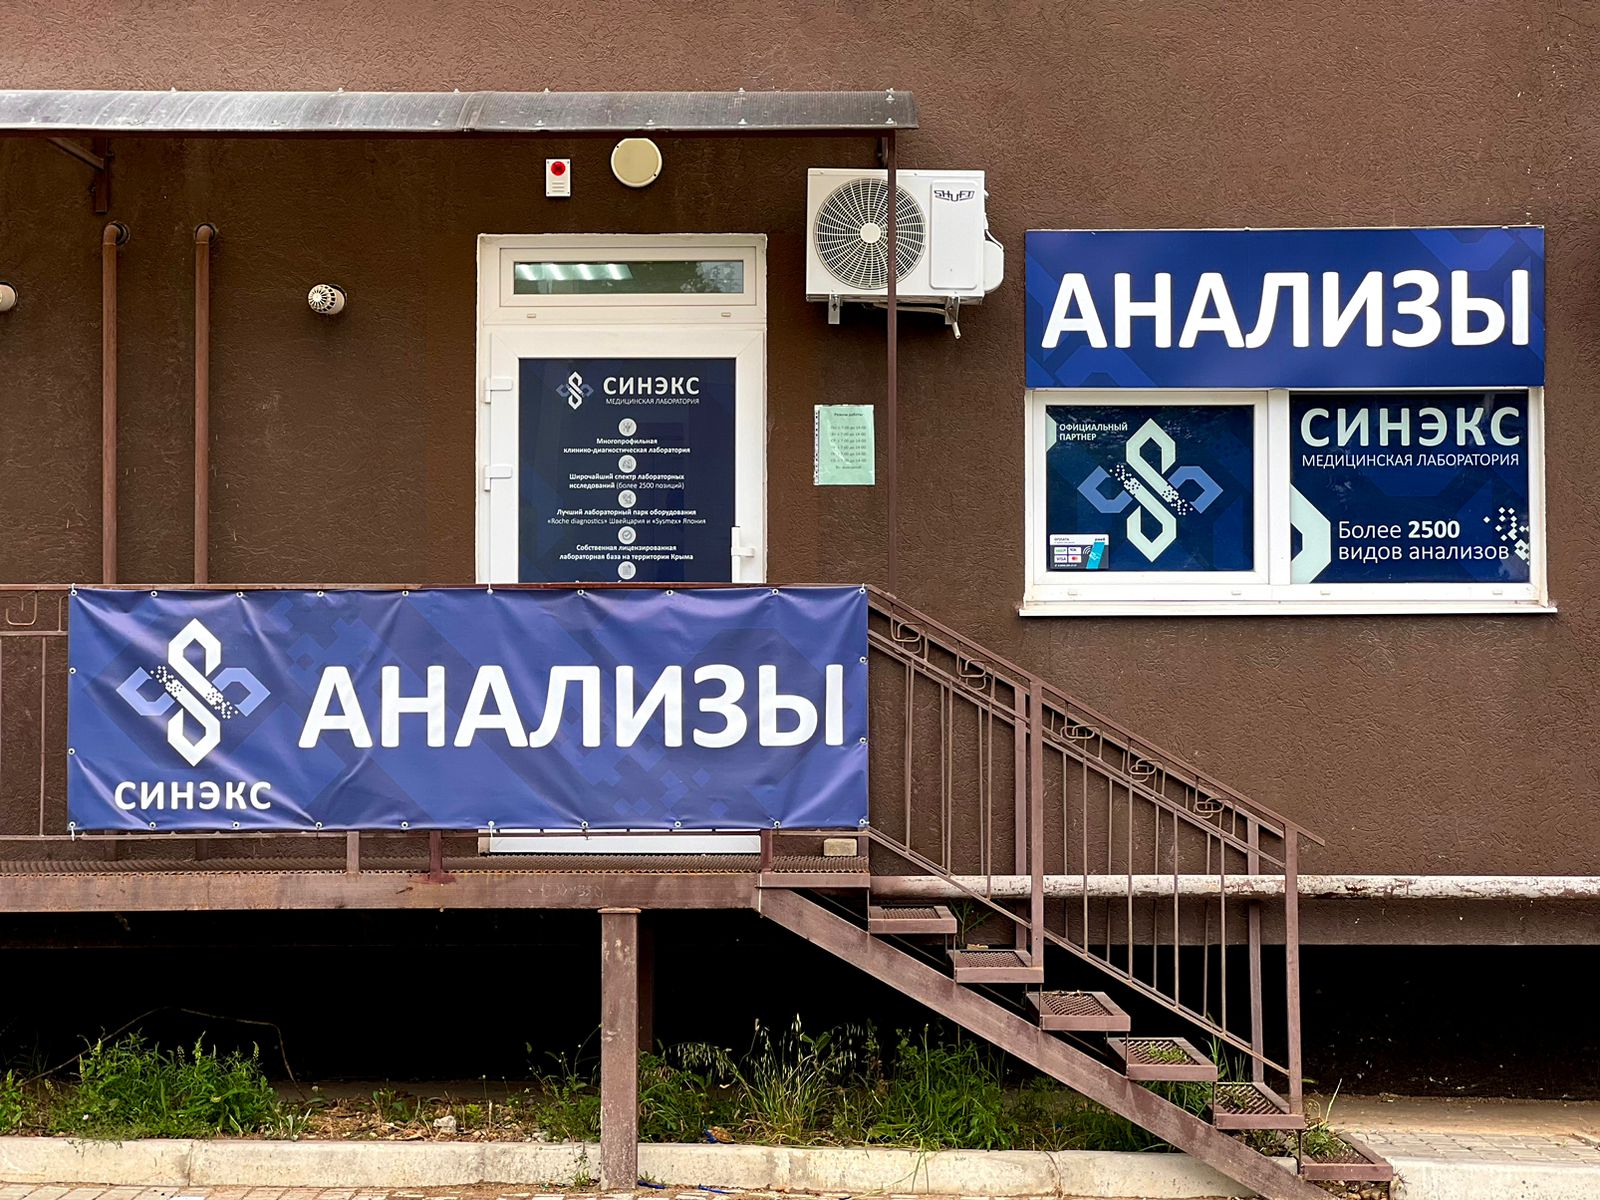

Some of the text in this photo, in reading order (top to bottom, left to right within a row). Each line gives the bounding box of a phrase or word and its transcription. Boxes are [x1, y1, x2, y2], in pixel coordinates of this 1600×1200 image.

[934, 190, 975, 202] SHUFT
[1041, 269, 1529, 349] АНАЛИЗЫ
[603, 376, 700, 395] СИНЭКС
[606, 398, 654, 406] МЕДИЦИНСКАЯ
[1059, 422, 1128, 433] ОФИЦИАЛЬНЫЙ
[1300, 407, 1520, 447] СИНЭКС
[596, 438, 658, 446] Многопрофильная
[1059, 433, 1097, 441] ПАРТНЕР
[563, 447, 647, 455] клинико-диагностическая
[1302, 453, 1519, 469] МЕДИЦИНСКАЯ ЛАБОРАТОРИЯ
[569, 473, 613, 481] Широчайший
[637, 473, 685, 481] лабораторных
[569, 482, 615, 490] исследований
[616, 482, 638, 490] (более
[655, 482, 685, 490] позиций)
[556, 509, 583, 517] Лучший
[584, 508, 632, 517] лабораторный
[649, 509, 697, 517] оборудования
[609, 518, 646, 526] Швейцария
[1339, 521, 1461, 539] Более 2500
[576, 544, 677, 552] Собственная лицензированная
[559, 553, 605, 561] лабораторная
[1339, 545, 1510, 563] видов анализов
[298, 664, 844, 749] АНАЛИЗЫ
[114, 781, 272, 810] СИНЭКС
